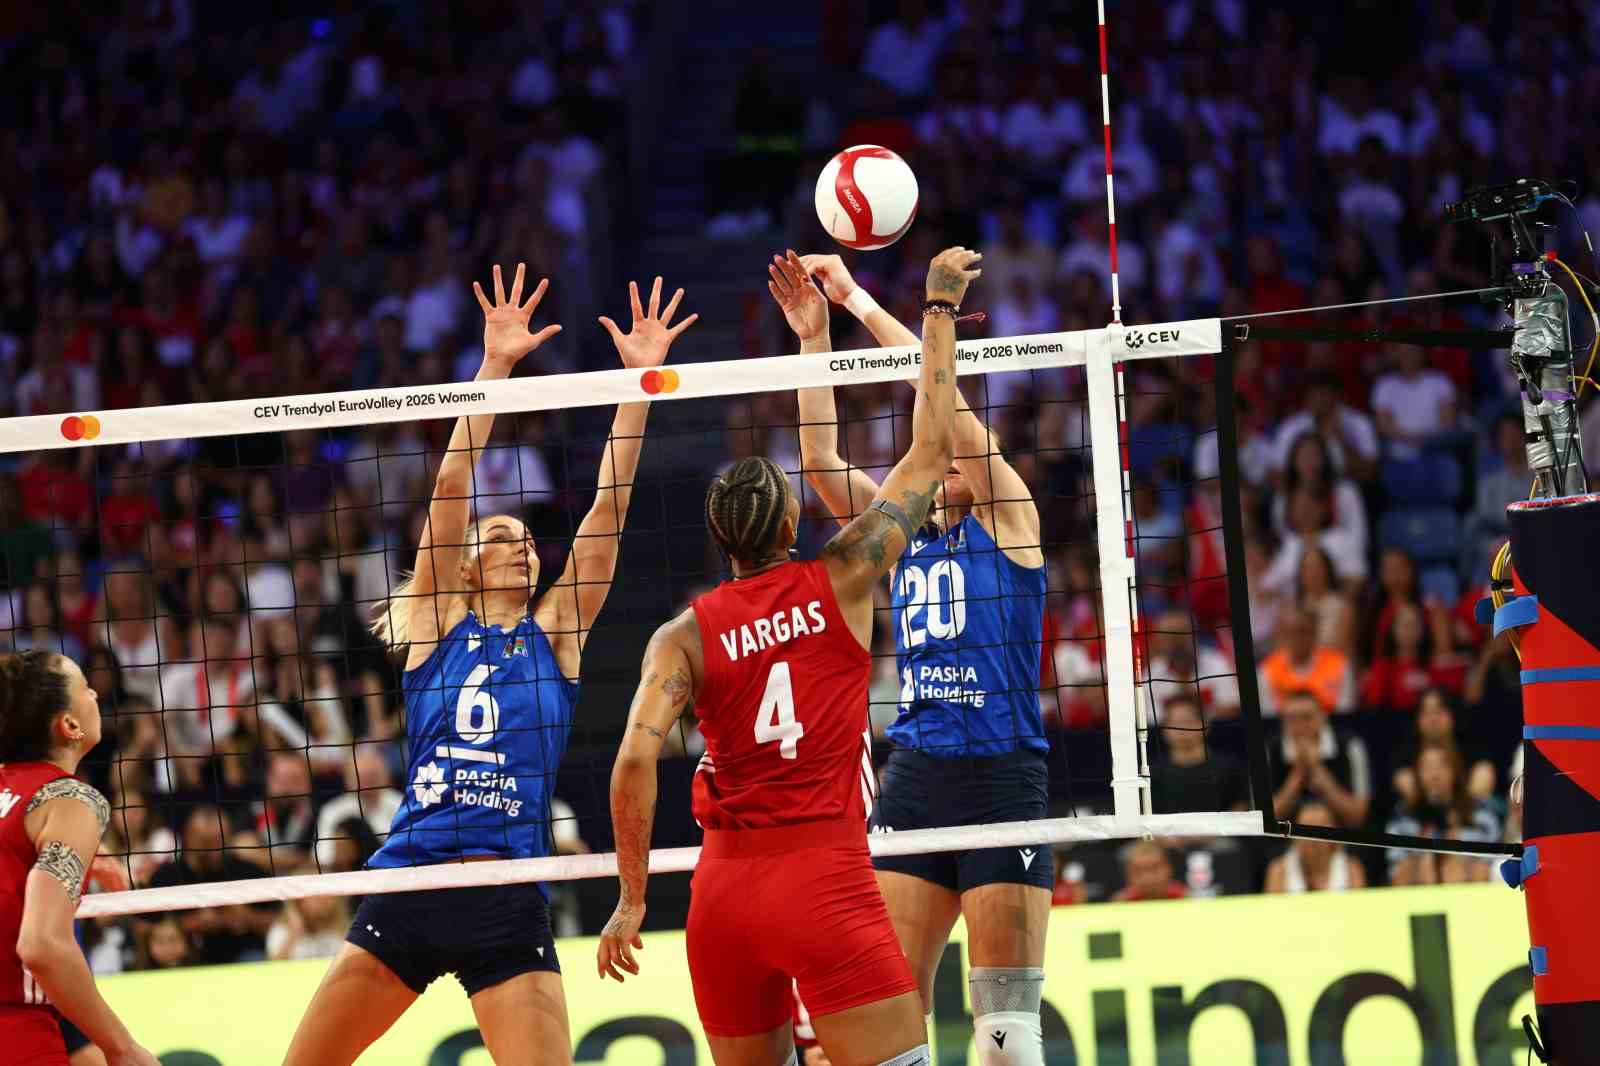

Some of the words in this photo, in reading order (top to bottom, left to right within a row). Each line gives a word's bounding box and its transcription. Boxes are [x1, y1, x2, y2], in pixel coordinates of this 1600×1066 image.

[1147, 330, 1180, 344] CEV
[829, 358, 855, 372] CEV
[858, 353, 912, 370] Trendyol
[982, 344, 1013, 359] 2026
[1015, 342, 1064, 356] Women
[253, 405, 279, 419] CEV
[282, 400, 336, 417] Trendyol
[339, 395, 403, 413] EuroVolley
[405, 393, 436, 407] 2026
[438, 390, 486, 404] Women
[900, 560, 966, 649] 20
[720, 601, 826, 662] VARGAS
[920, 666, 978, 683] PASHA
[455, 664, 500, 745] 6
[754, 661, 804, 760] 4
[920, 684, 987, 708] Holding
[455, 768, 518, 792] PASHA
[454, 788, 523, 817] Holding
